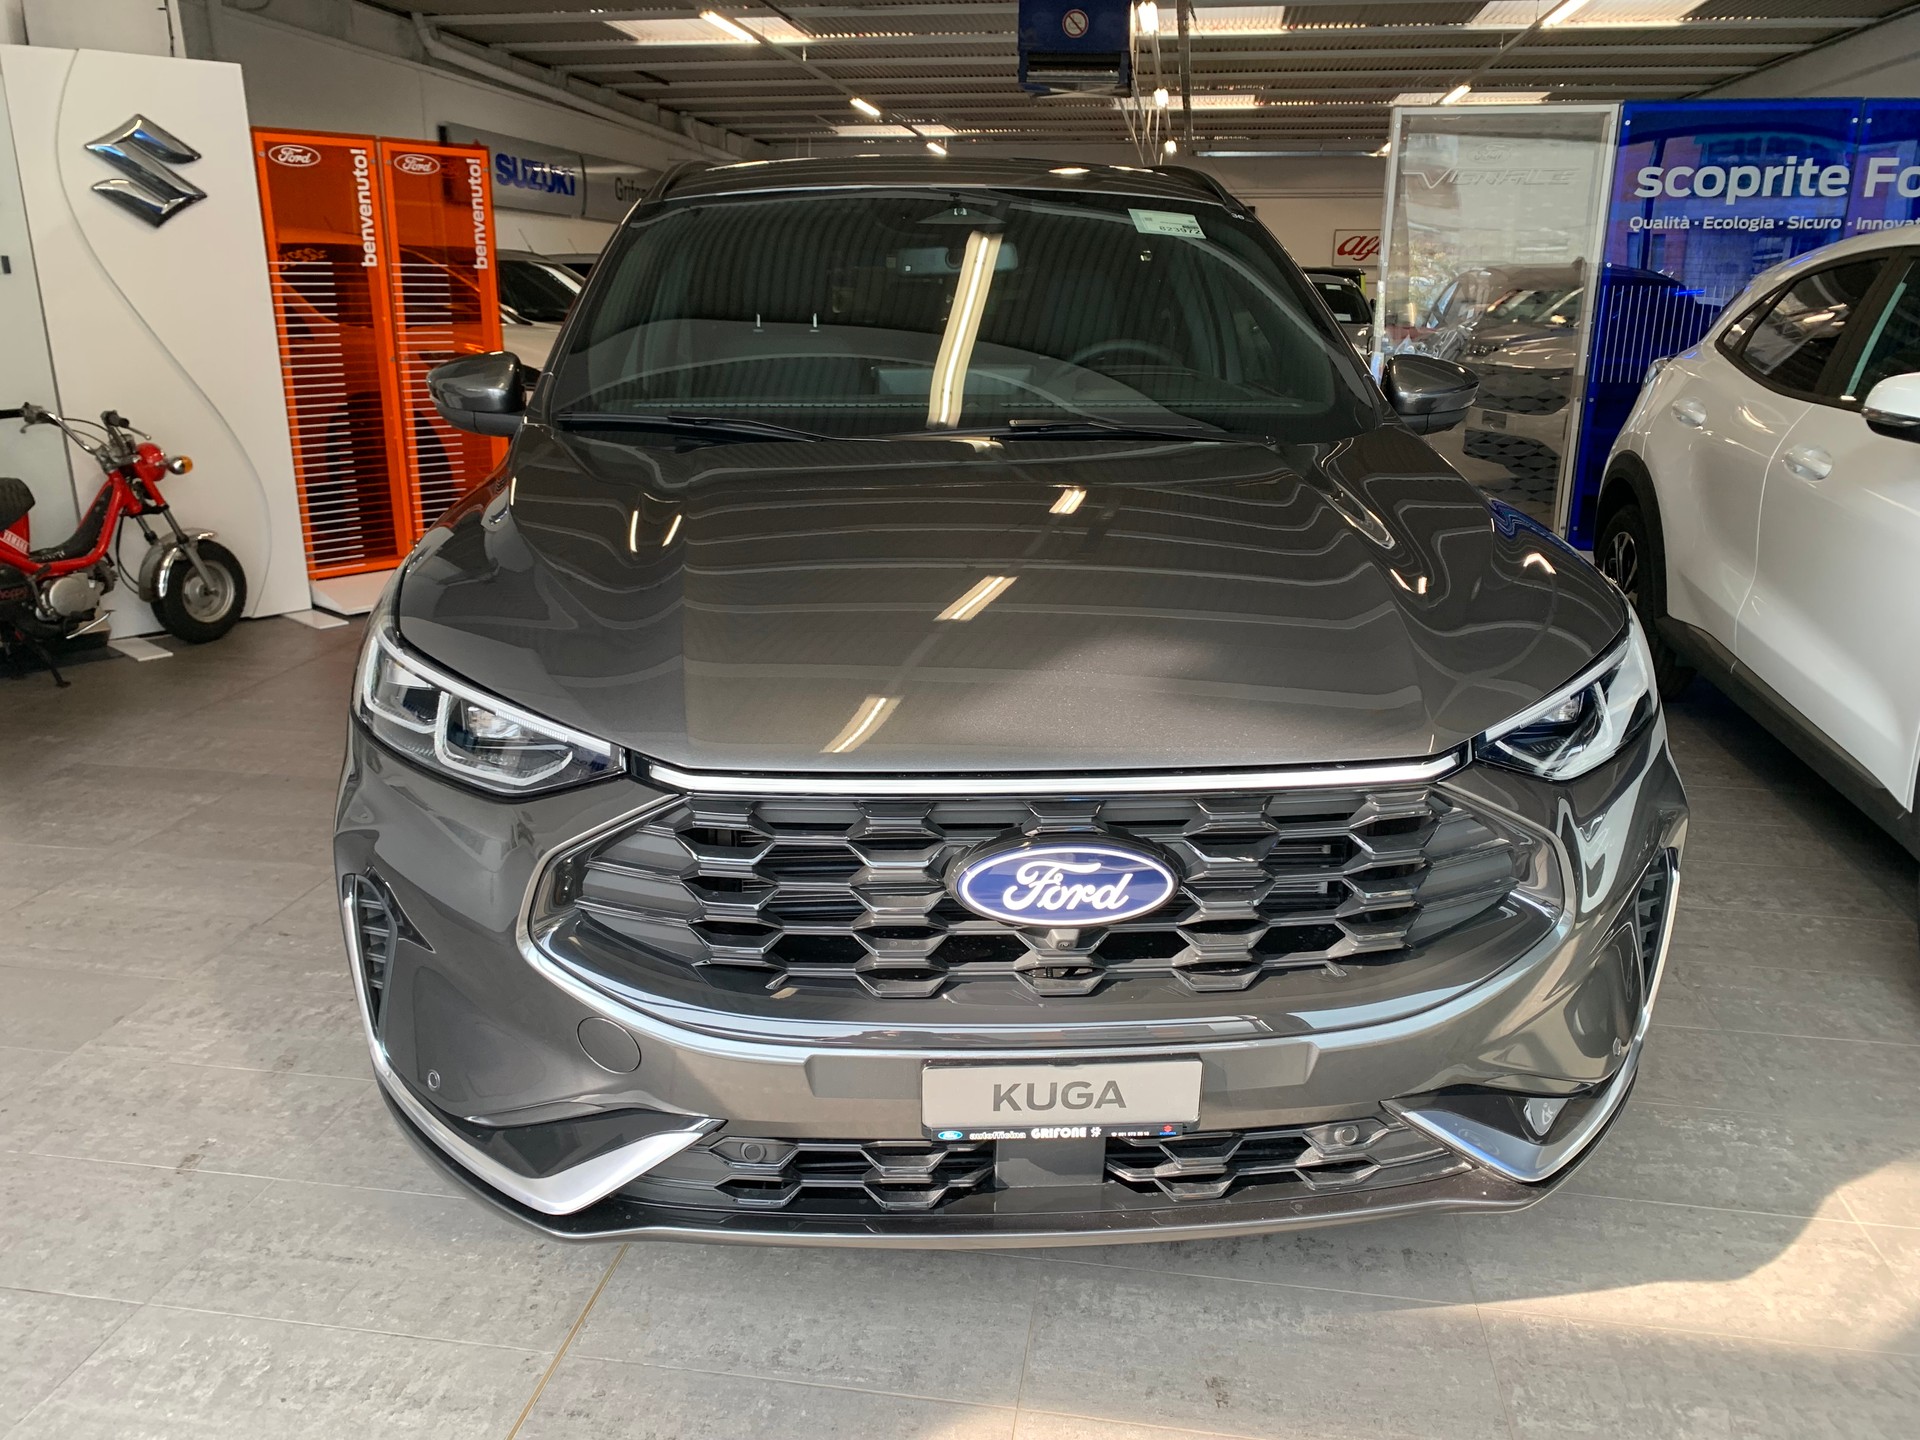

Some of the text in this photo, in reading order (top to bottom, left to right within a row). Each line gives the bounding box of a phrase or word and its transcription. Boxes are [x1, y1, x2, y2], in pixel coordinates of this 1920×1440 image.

[278, 146, 312, 164] Ford
[402, 156, 432, 173] Ford
[495, 153, 575, 196] SUZUKI
[1634, 155, 1850, 206] scoprite
[350, 148, 378, 267] benvenuto!
[466, 158, 488, 270] benvenuto!
[1629, 215, 1691, 232] Qualità
[1702, 216, 1775, 232] Ecologia
[1786, 216, 1842, 230] Sicuro
[1002, 860, 1133, 911] Ford
[992, 1080, 1127, 1112] KUGA
